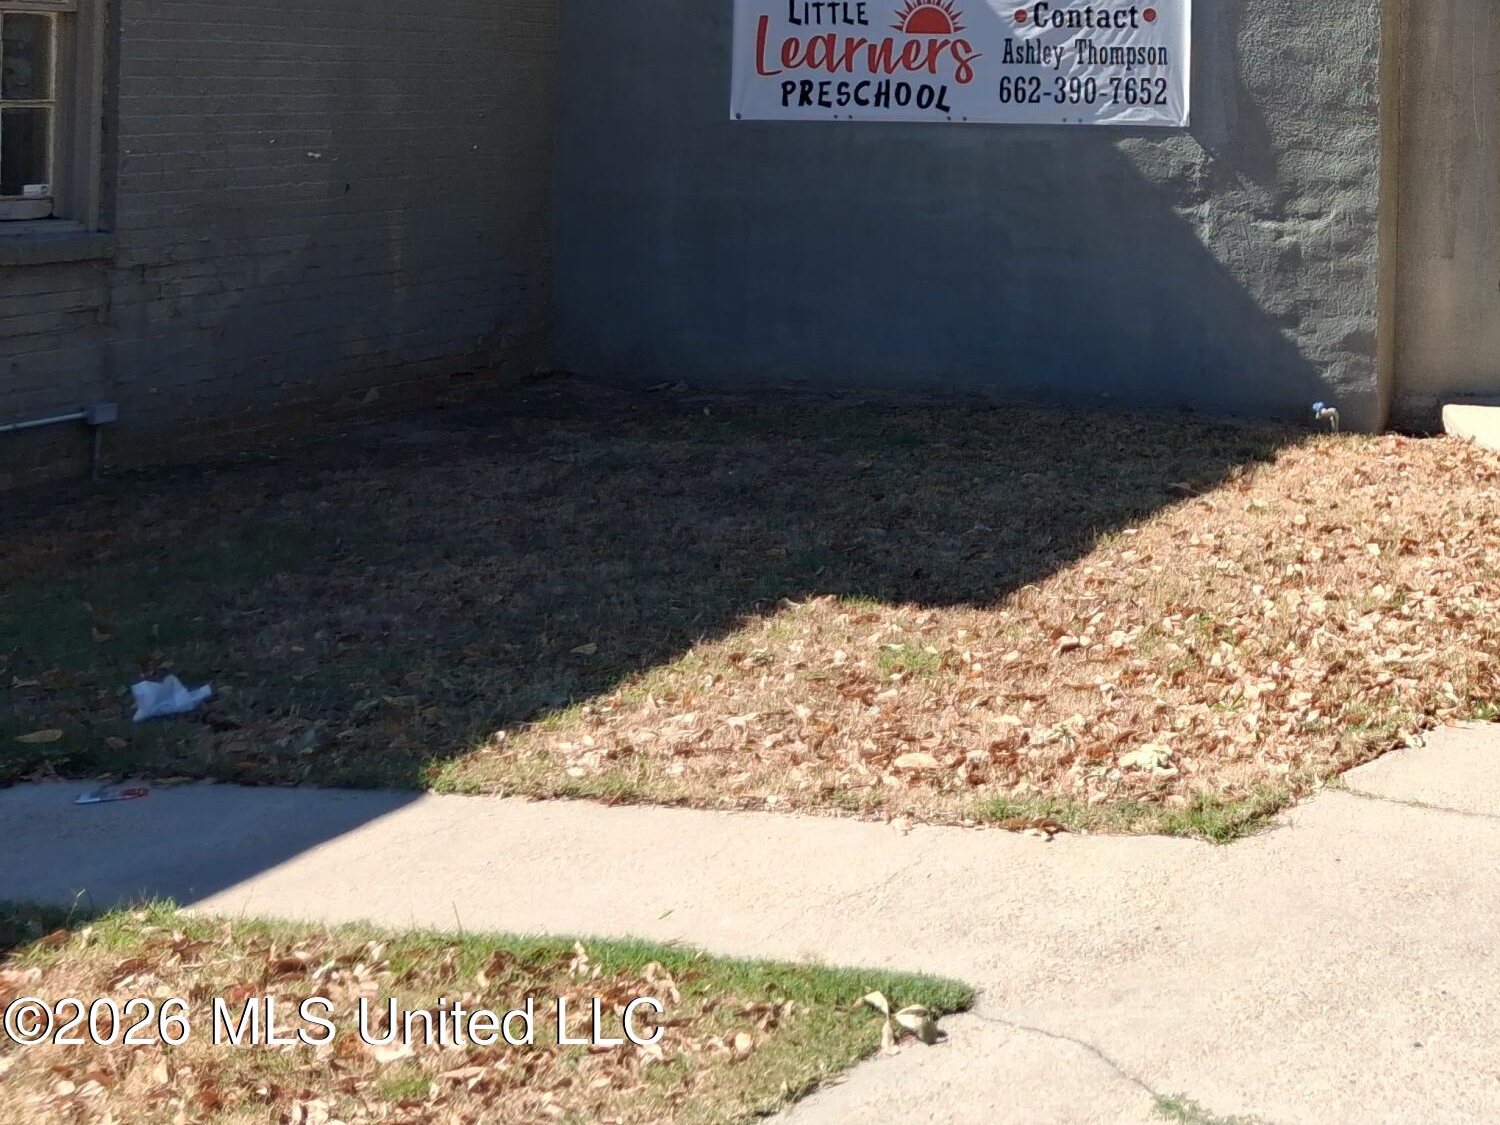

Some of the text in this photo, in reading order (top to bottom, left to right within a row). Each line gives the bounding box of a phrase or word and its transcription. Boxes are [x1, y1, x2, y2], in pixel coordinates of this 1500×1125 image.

[788, 0, 869, 26] LITTLE
[1033, 2, 1139, 29] Contact
[756, 14, 982, 85] Learners
[1002, 38, 1168, 70] Ashley Thompson
[781, 79, 951, 112] PRESCHOOL
[999, 77, 1168, 105] 662-390-7652
